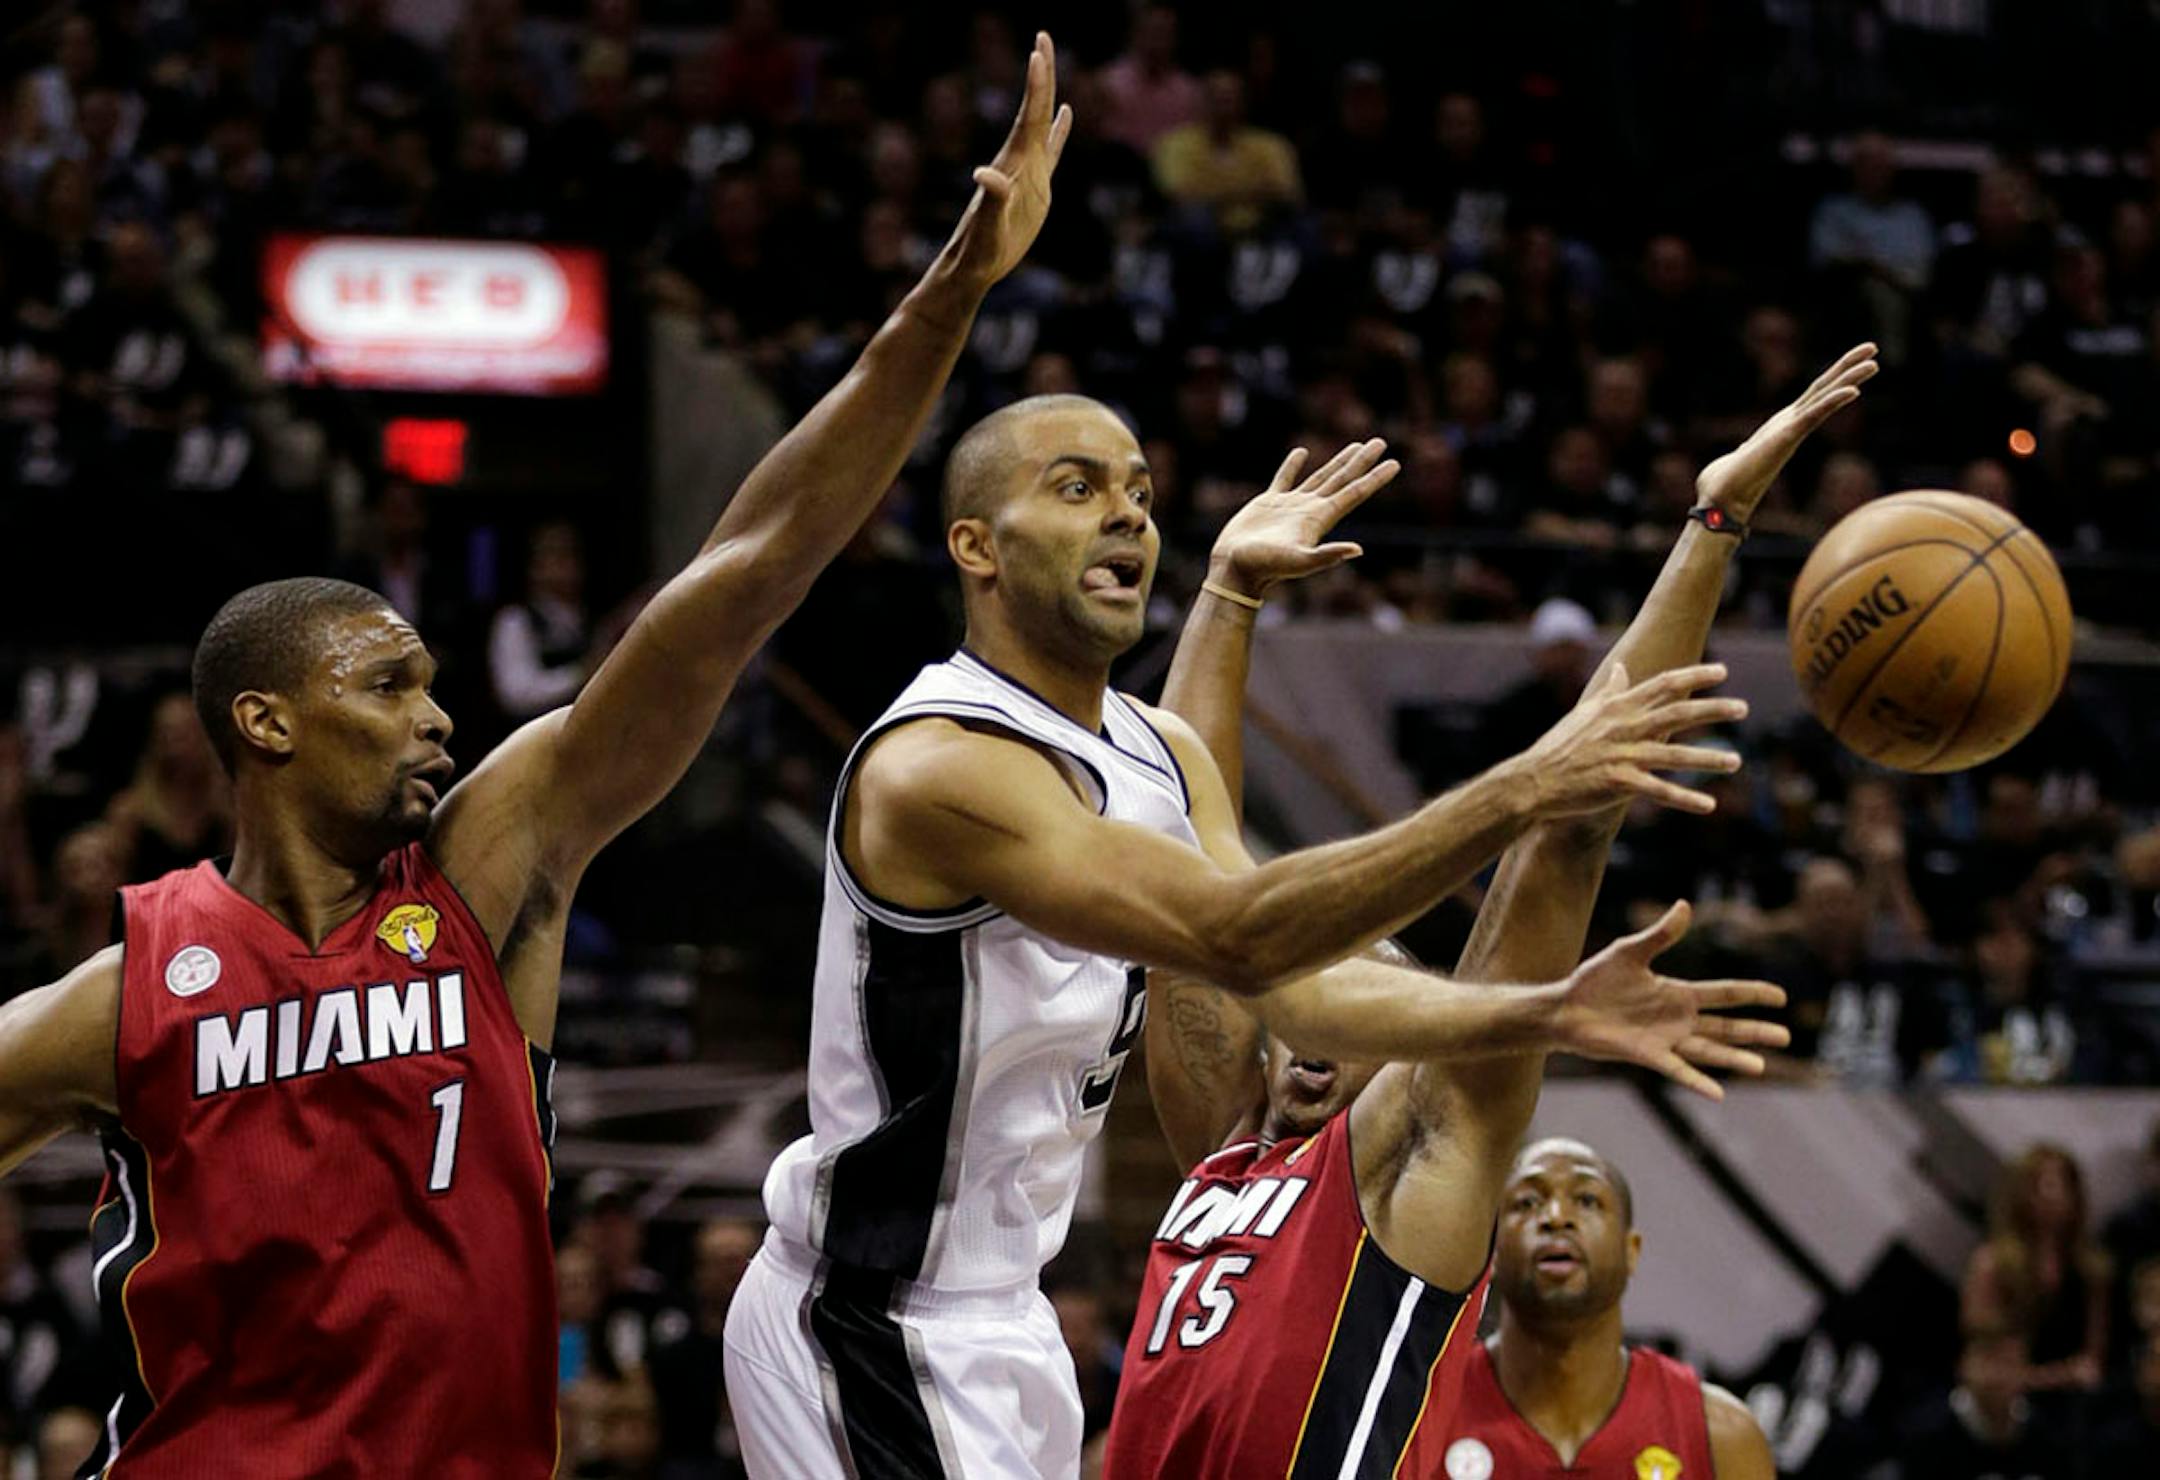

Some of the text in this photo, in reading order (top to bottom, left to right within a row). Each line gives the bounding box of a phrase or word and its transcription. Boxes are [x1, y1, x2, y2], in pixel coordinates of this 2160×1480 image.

[195, 970, 466, 1098] MIAMI
[428, 1079, 464, 1192] 1
[1146, 1254, 1255, 1357] 15
